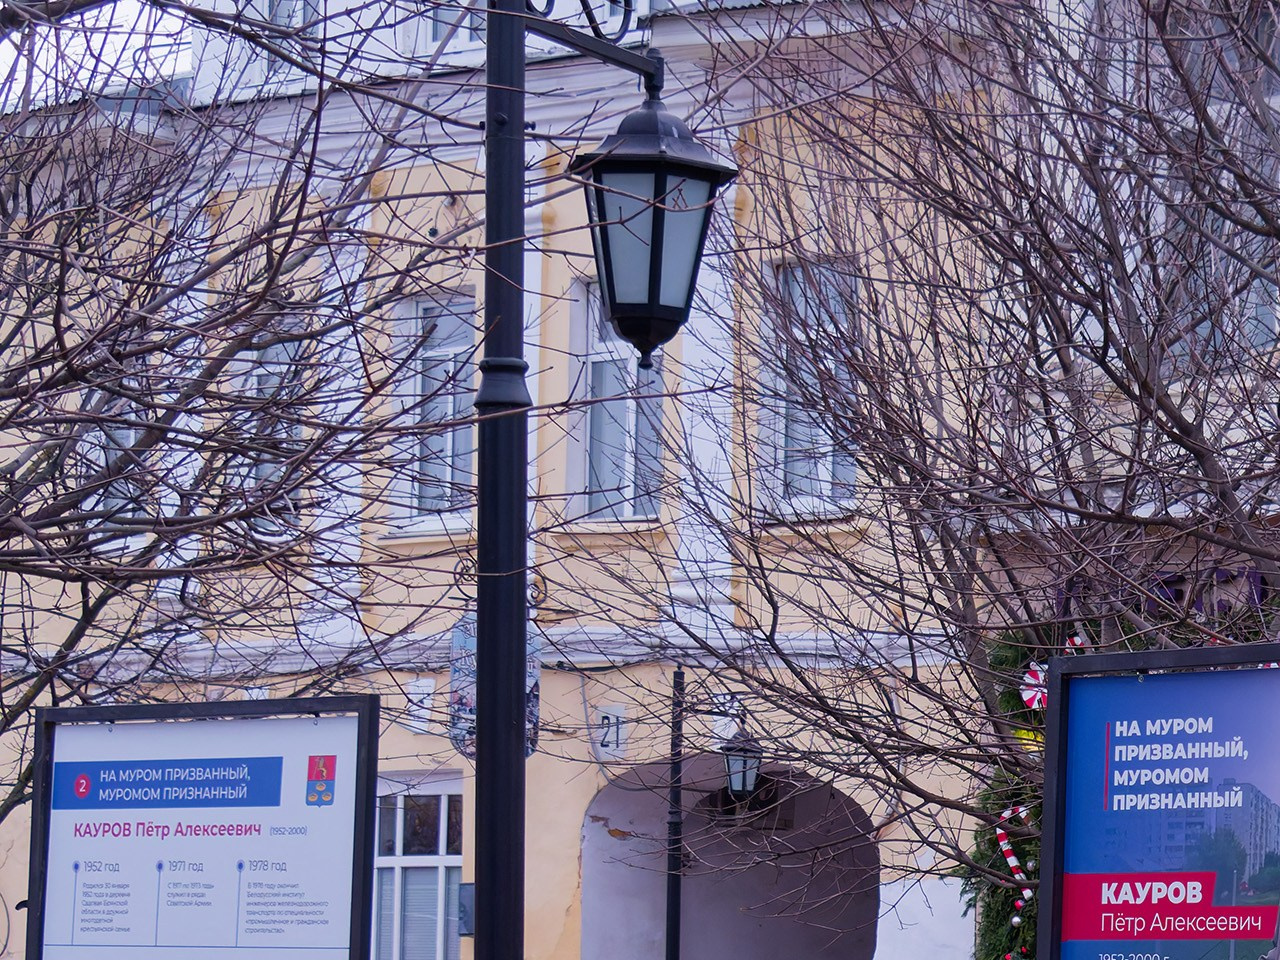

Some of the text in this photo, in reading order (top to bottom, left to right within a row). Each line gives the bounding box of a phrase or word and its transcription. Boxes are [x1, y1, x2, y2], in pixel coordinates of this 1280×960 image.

[600, 715, 619, 748] 21
[1115, 717, 1213, 737] НА МУРОМ
[1114, 736, 1249, 761] ПРИЗВАННЫЙ,
[100, 764, 251, 783] НА МУРОМ ПРИЗВАННЫЙ,
[1113, 767, 1209, 786] МУРОМОМ
[79, 780, 86, 792] 2
[99, 784, 247, 801] МУРОМОМ ПРИЗНАННЫЙ
[1113, 786, 1243, 811] ПРИЗНАННЫЙ
[74, 822, 132, 838] КАУРОВ
[135, 821, 171, 840] Пётр
[174, 821, 262, 837] Алексеевич
[84, 861, 120, 873] 1952 год
[168, 860, 204, 873] 1971 год
[249, 860, 287, 873] 1978 год
[1101, 881, 1203, 905] КАУРОВ
[1101, 912, 1262, 936] Пётр Алексеевич
